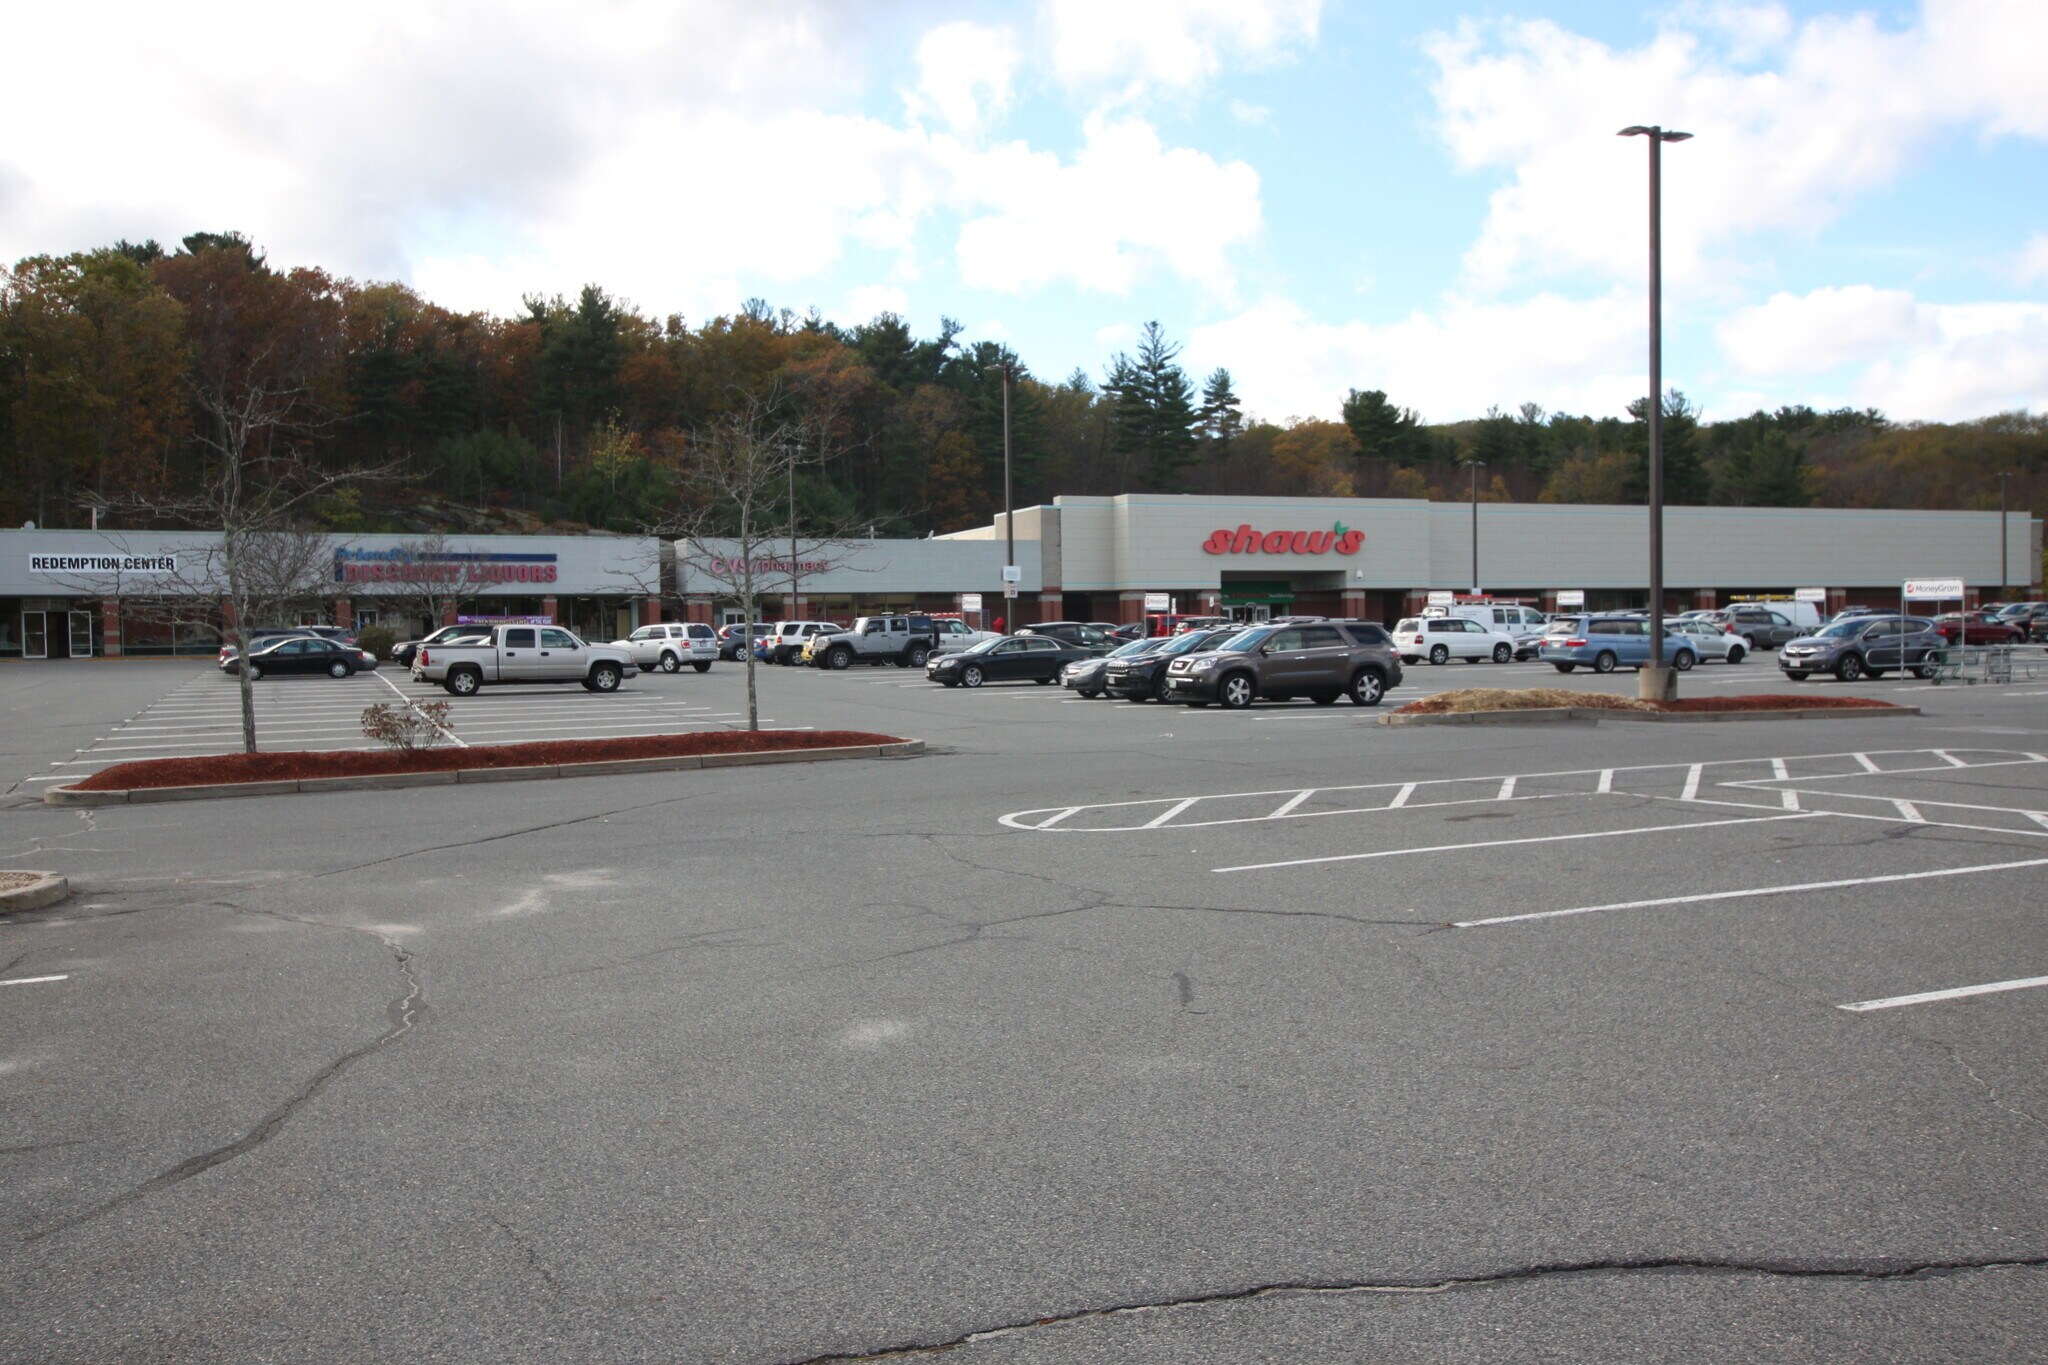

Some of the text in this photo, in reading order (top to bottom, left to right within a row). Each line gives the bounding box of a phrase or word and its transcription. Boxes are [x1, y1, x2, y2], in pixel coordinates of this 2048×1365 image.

[32, 557, 175, 570] REDEMPTION CENTER
[344, 563, 558, 584] DISCOUNT LIQUORS
[1915, 584, 1960, 593] MoneyGram
